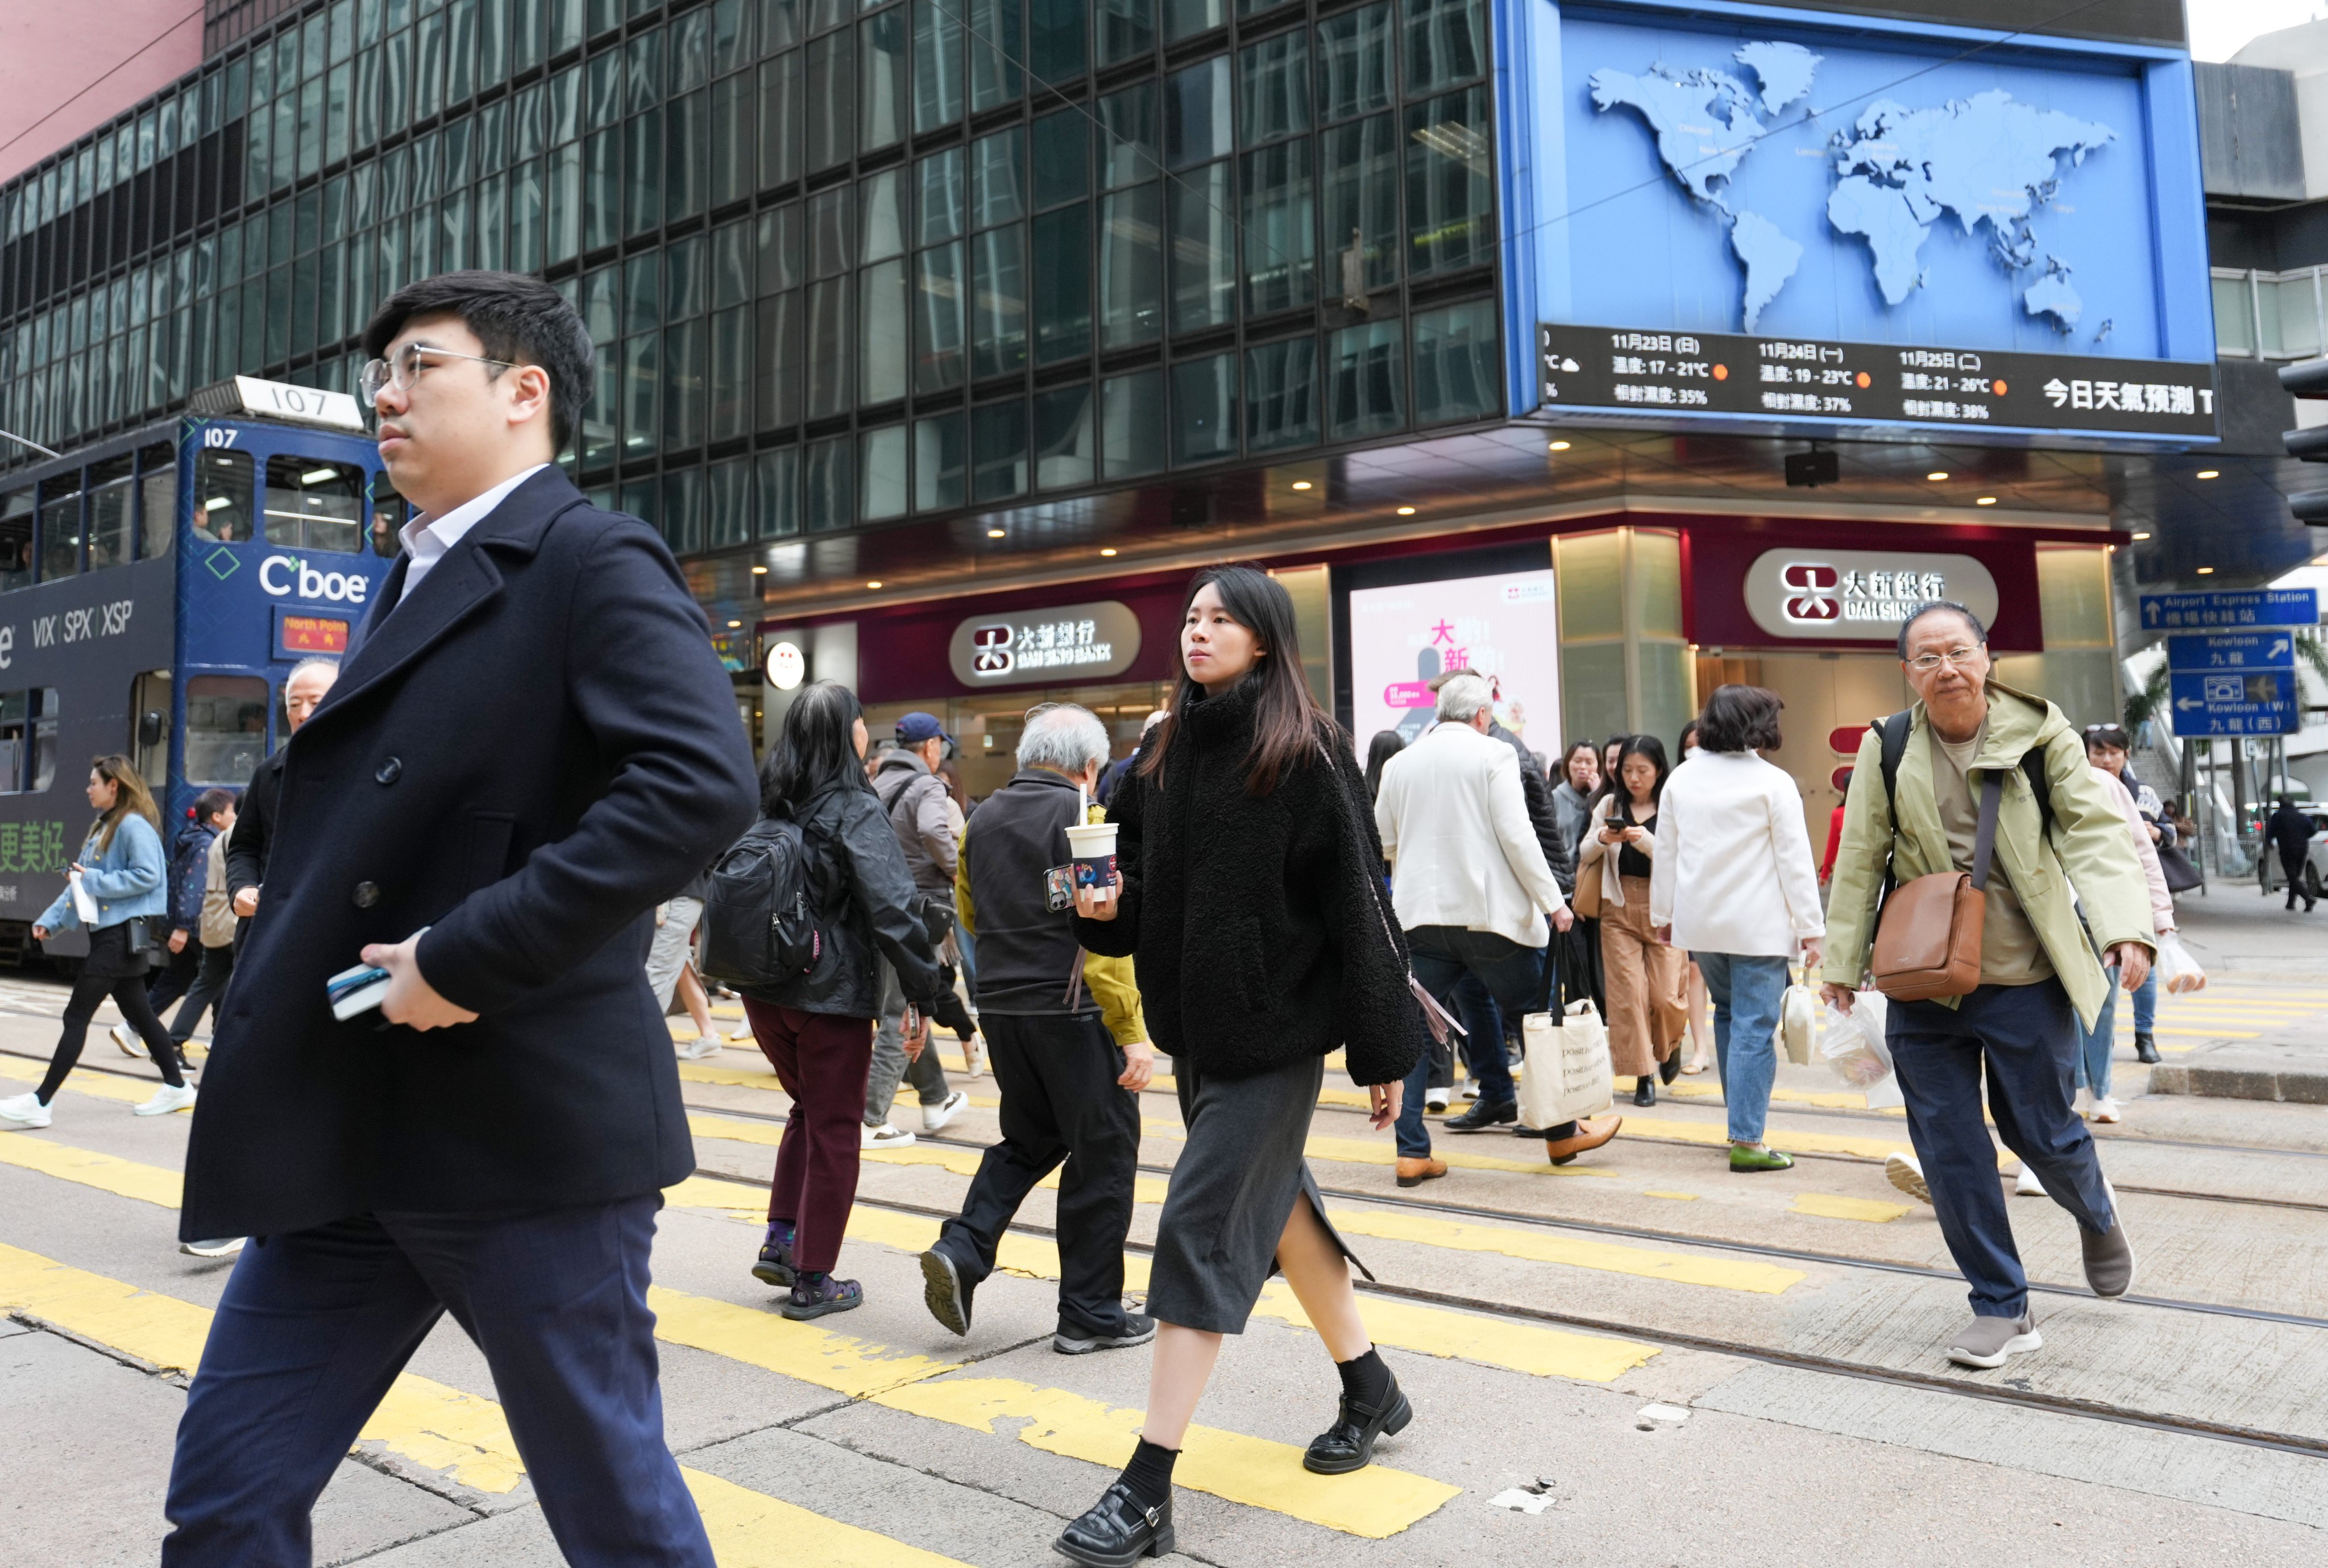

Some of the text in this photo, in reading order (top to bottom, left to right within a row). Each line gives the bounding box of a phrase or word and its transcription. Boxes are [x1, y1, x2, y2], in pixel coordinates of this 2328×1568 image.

[1611, 334, 1671, 352] 11月23日
[1759, 342, 1816, 360] 11月24日
[1649, 360, 1666, 375] 17
[1899, 350, 1955, 369] 11月25日
[1794, 368, 1811, 383] 19
[1933, 376, 1949, 391] 21
[272, 387, 326, 415] 107
[2043, 377, 2194, 414] 今日天氣預測
[205, 429, 238, 448] 107
[1843, 570, 1945, 601] 大新銀行
[2165, 592, 2309, 608] Airport Express Station
[1845, 600, 1880, 620] DAH
[33, 600, 132, 648] VIX SPX XSP
[285, 616, 347, 633] North Point
[2208, 636, 2259, 648] Kowloon
[2210, 652, 2244, 666] 九龍
[2208, 702, 2259, 713] Kowloon
[1563, 1064, 1593, 1078] positive
[1563, 1081, 1591, 1098] positive
